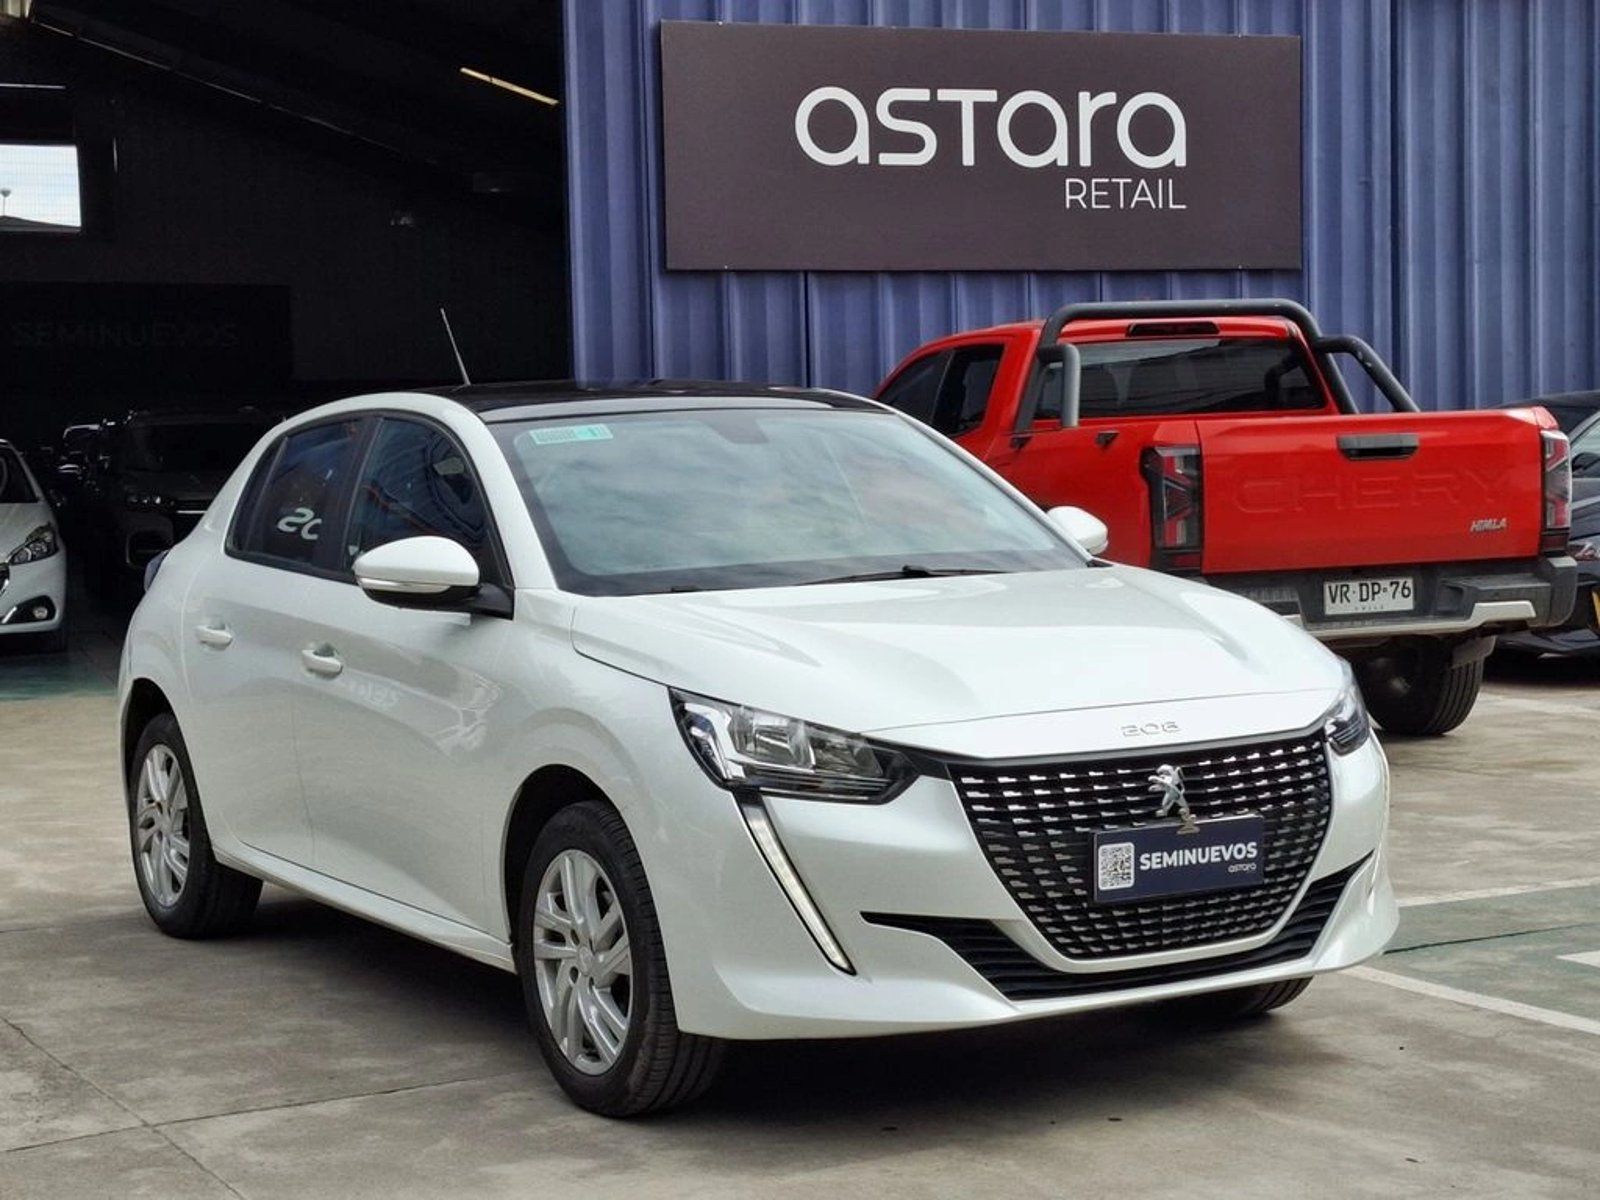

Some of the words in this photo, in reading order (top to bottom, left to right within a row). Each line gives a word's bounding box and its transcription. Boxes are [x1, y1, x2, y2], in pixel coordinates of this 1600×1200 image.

[1065, 178, 1187, 210] RETAIL
[1233, 468, 1510, 513] CHERY
[1139, 841, 1258, 871] SEMINUEVOS
